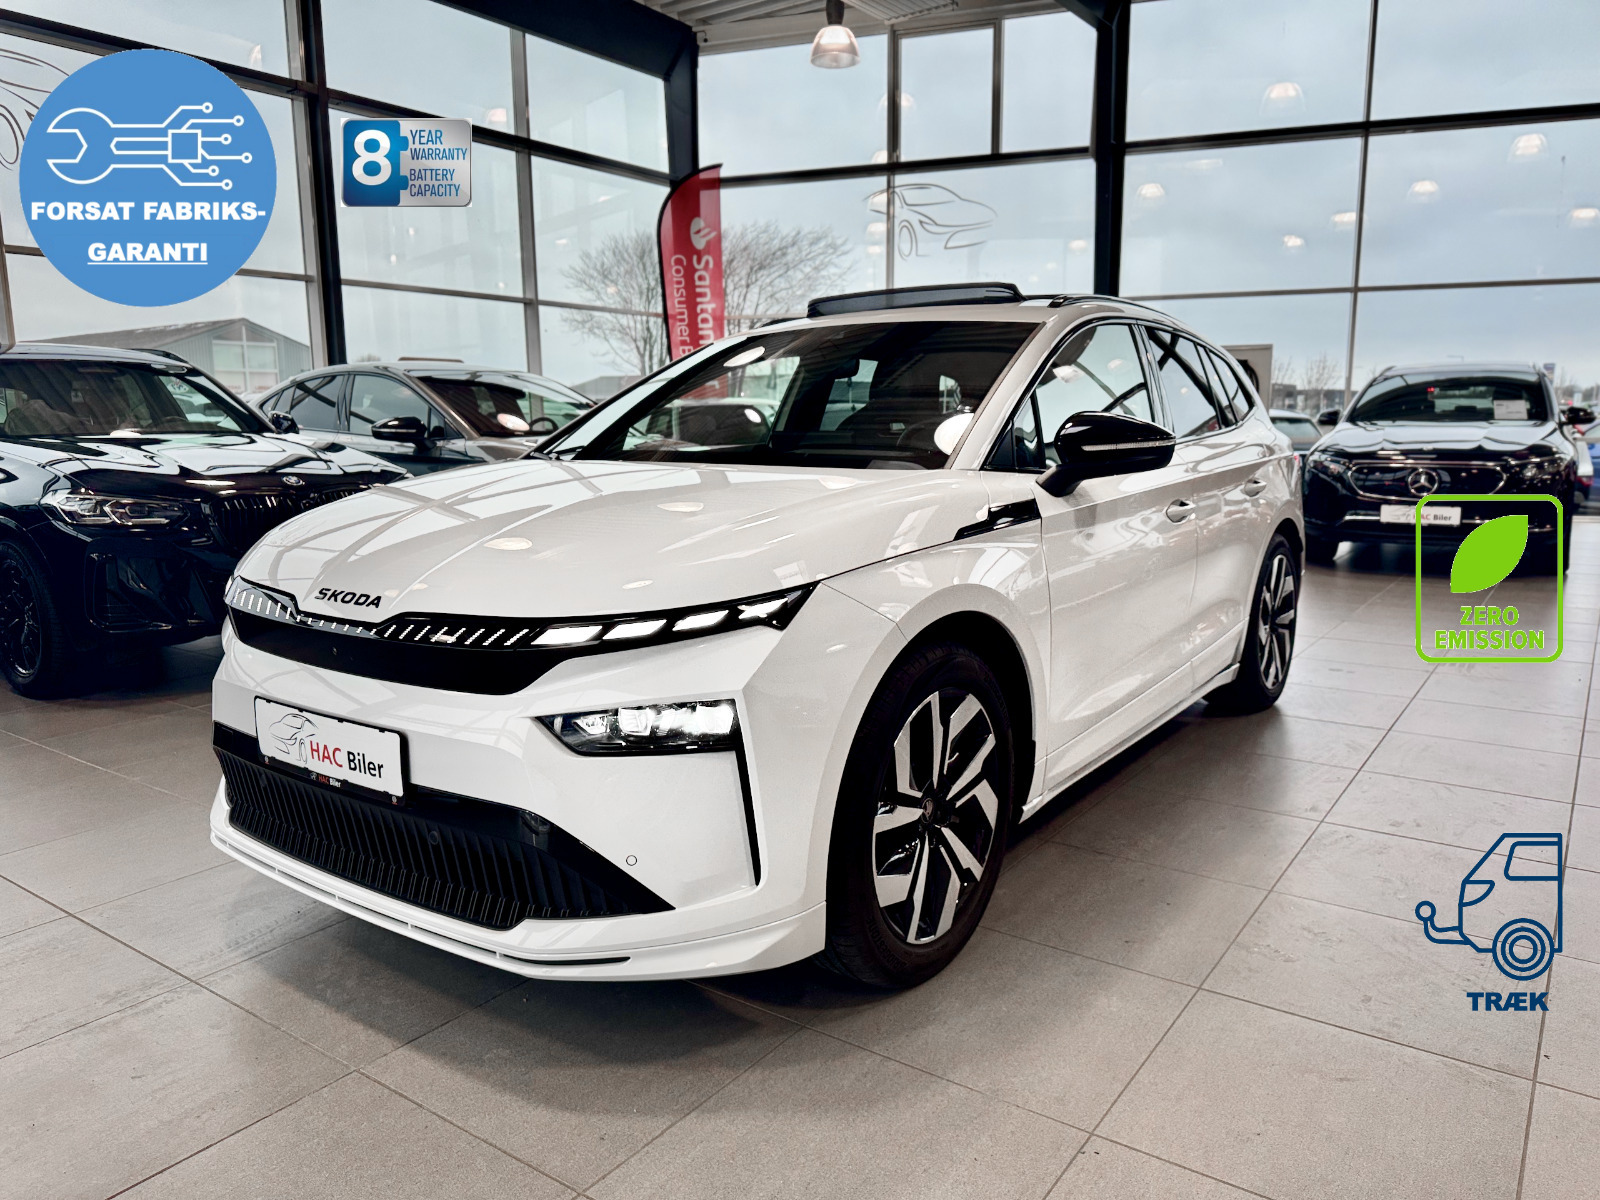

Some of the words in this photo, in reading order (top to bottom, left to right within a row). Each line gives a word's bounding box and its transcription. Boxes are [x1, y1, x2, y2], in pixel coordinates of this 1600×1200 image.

[671, 254, 690, 343] Consumer
[1433, 513, 1452, 521] Biler
[314, 587, 383, 608] SKODA
[310, 740, 343, 768] HAC
[347, 751, 384, 779] Biler
[318, 774, 330, 785] HAC
